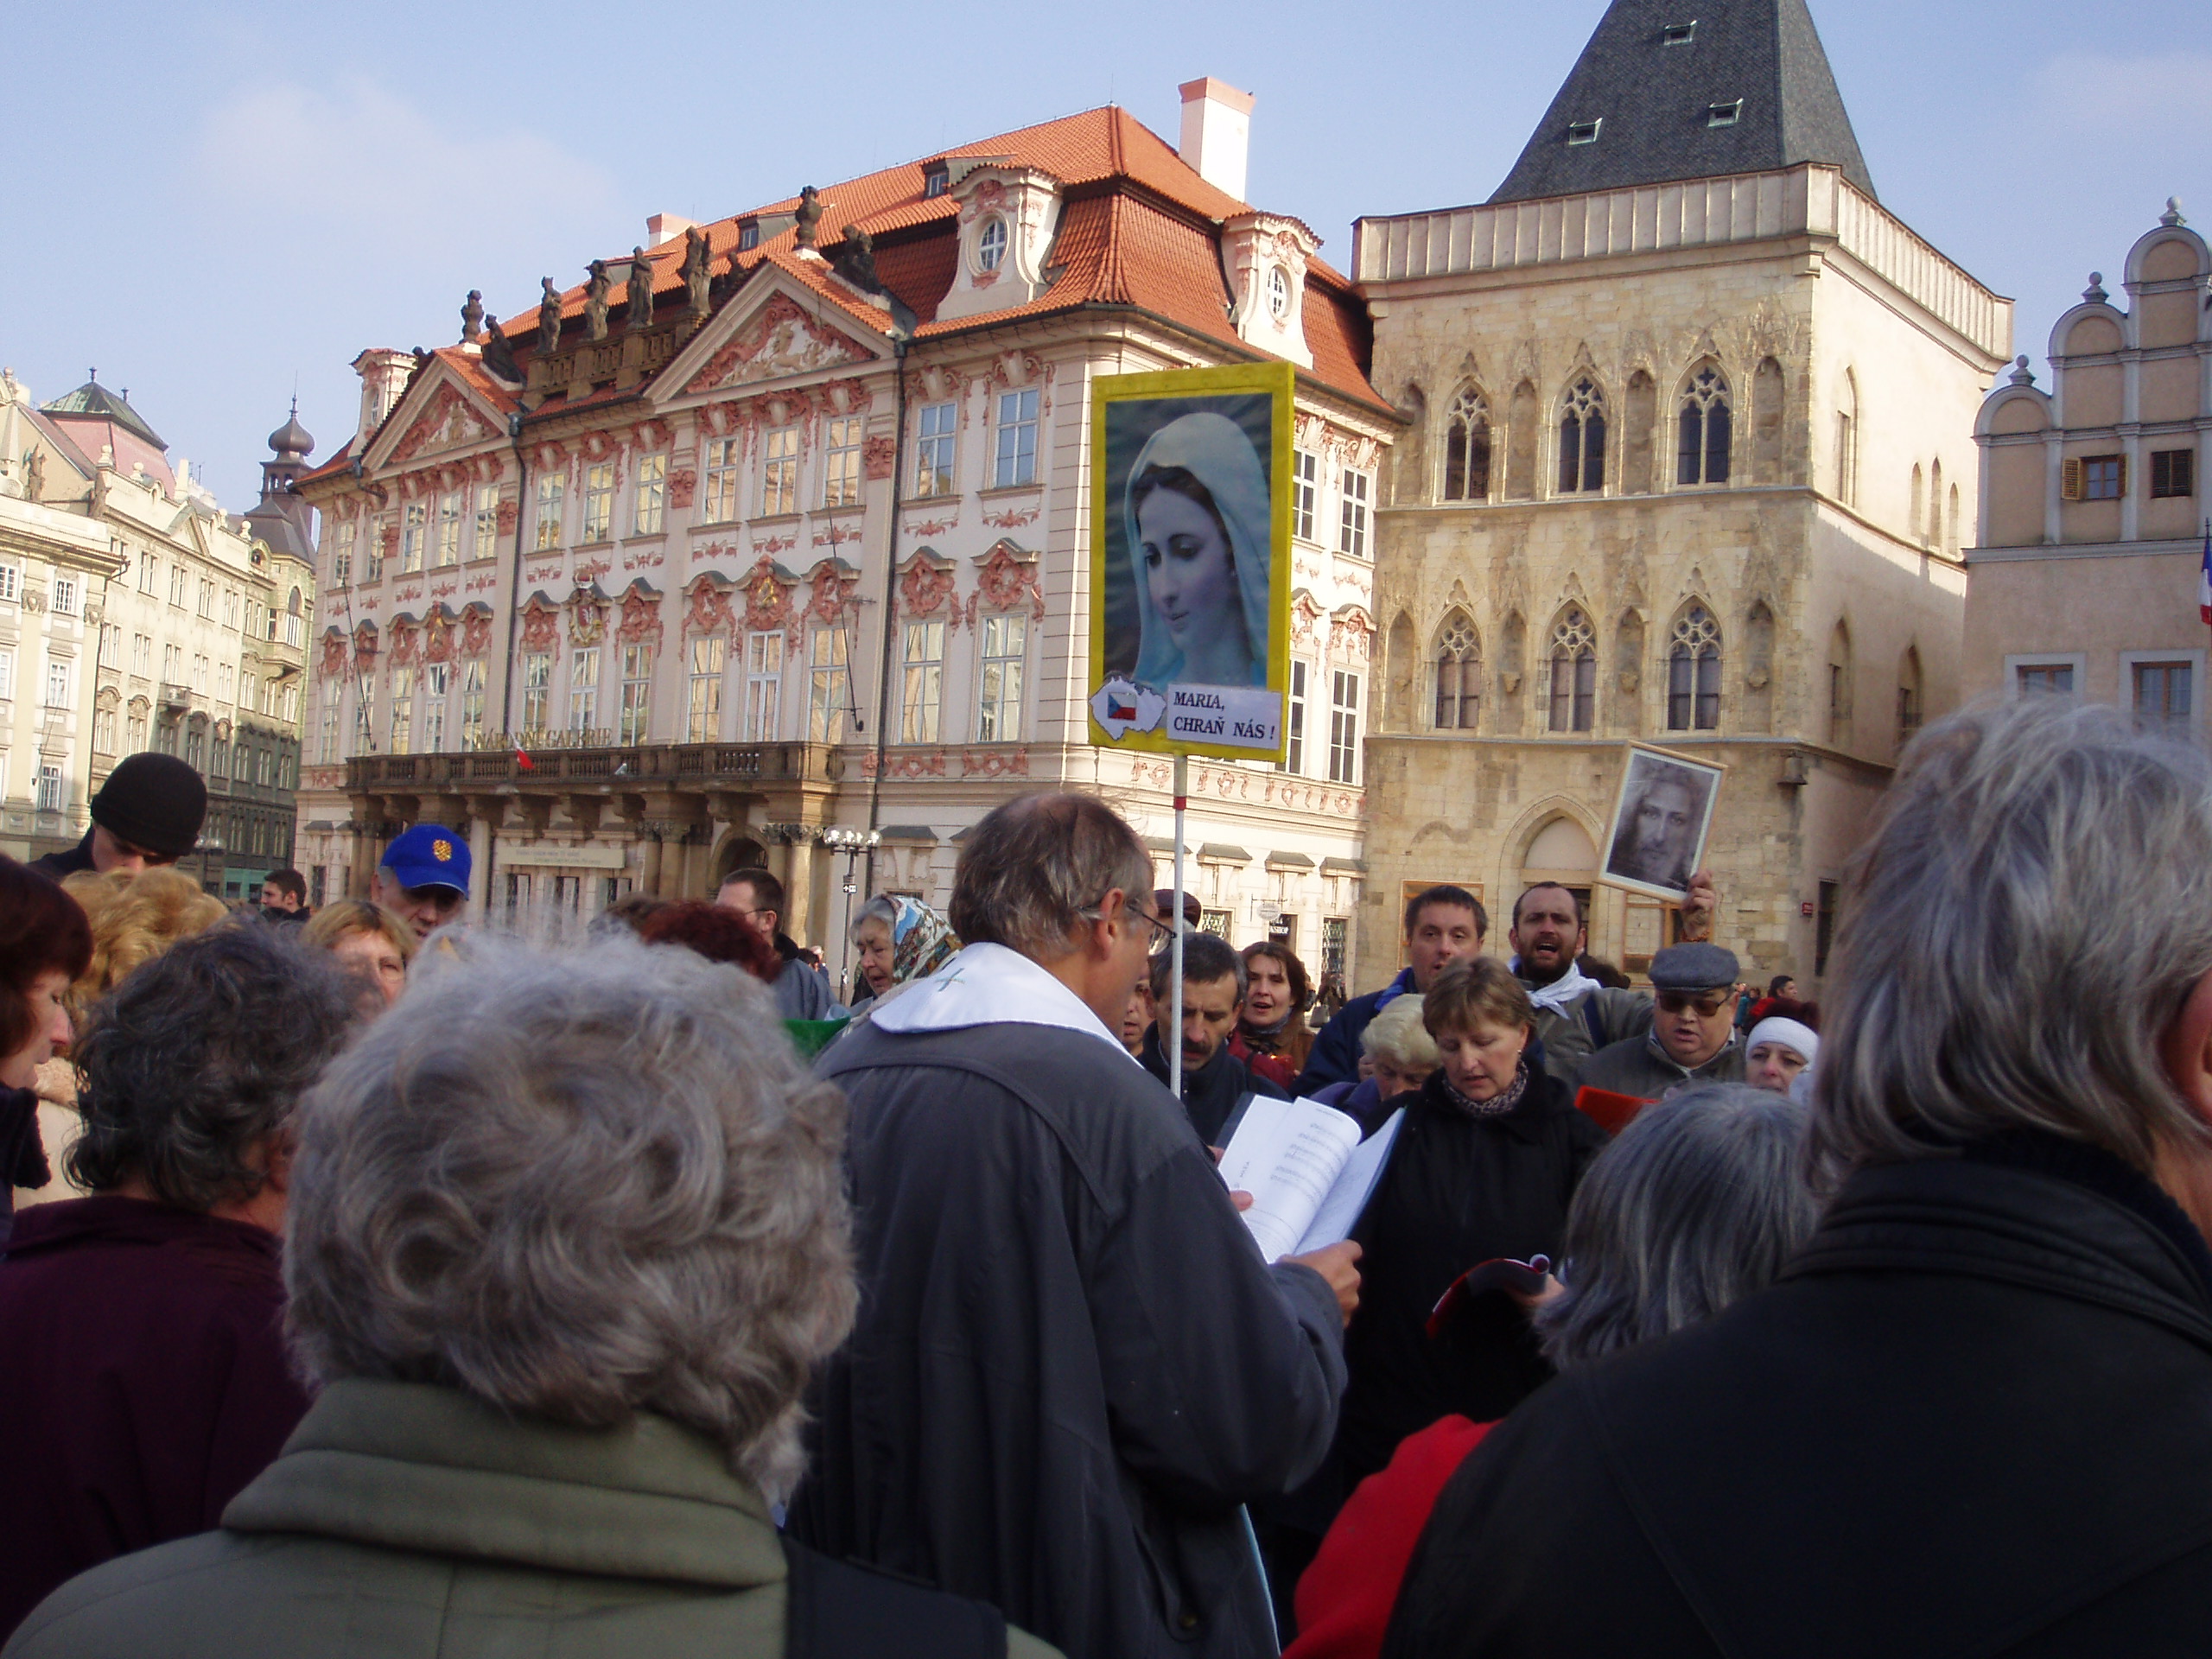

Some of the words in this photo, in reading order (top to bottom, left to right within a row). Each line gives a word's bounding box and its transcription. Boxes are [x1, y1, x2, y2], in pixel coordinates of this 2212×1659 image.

[1173, 691, 1225, 712] MARIA,
[1173, 715, 1225, 735] CHRAŇ
[545, 728, 612, 747] GALERIE
